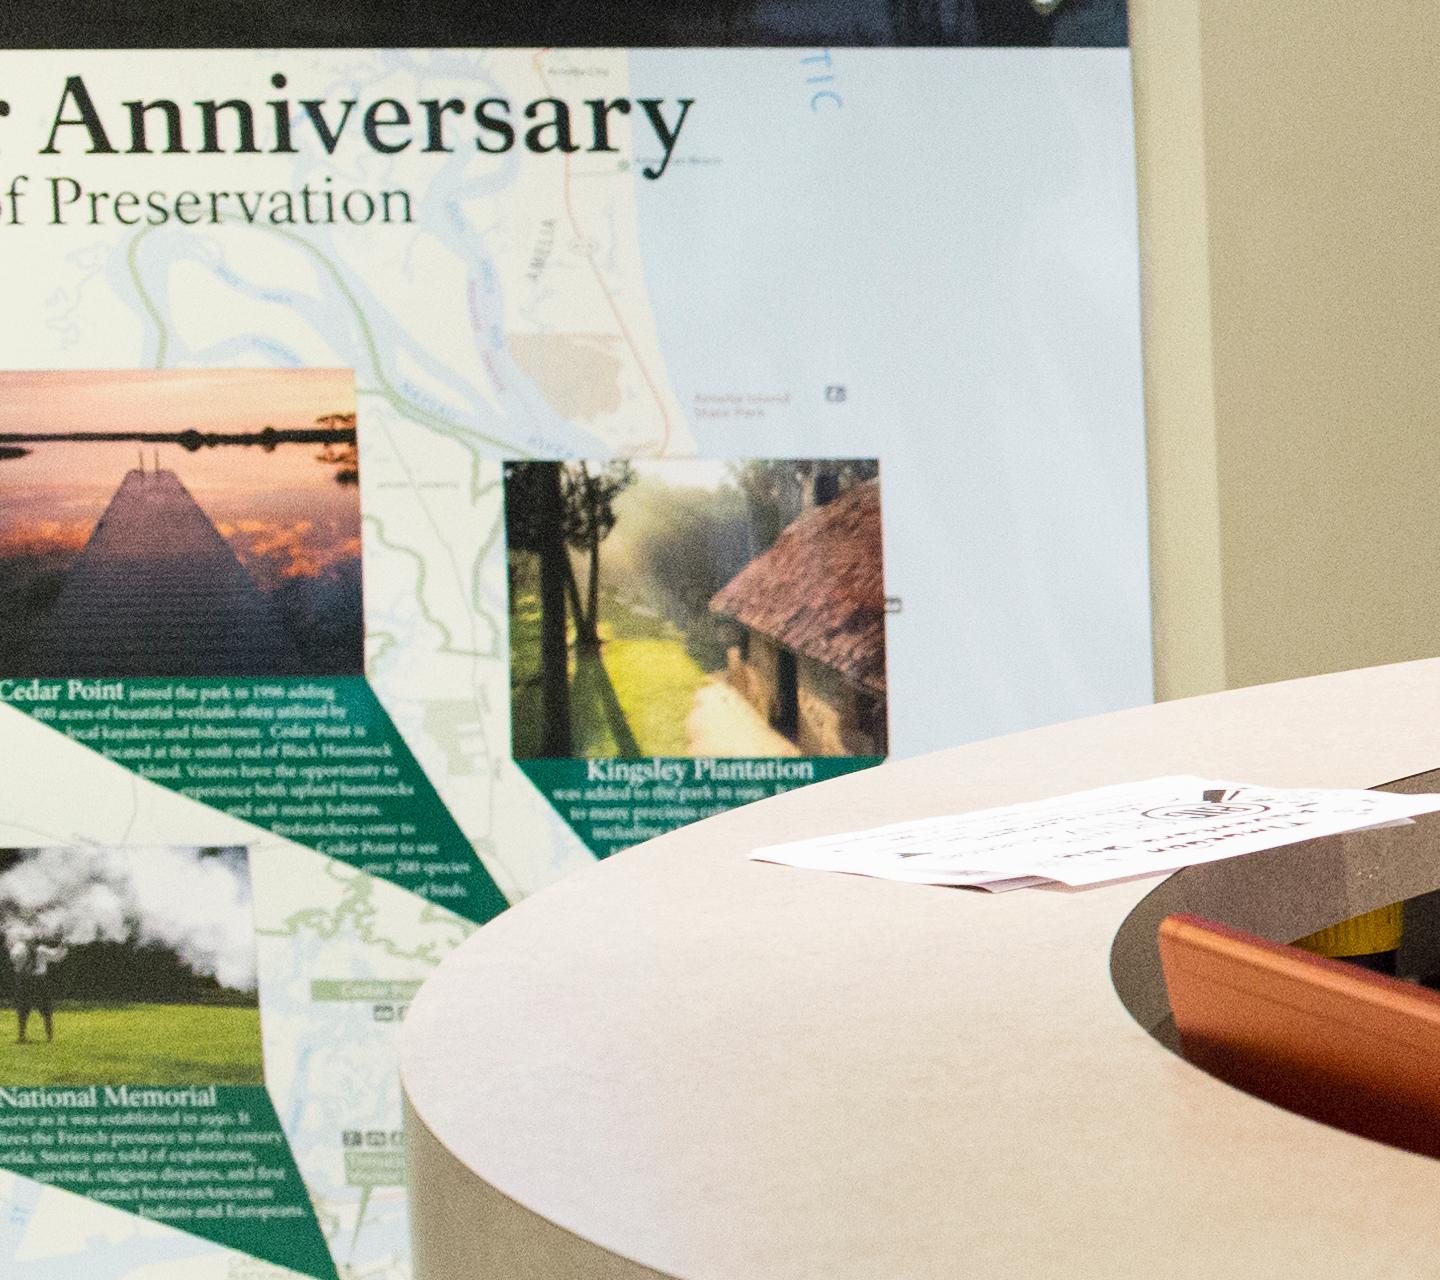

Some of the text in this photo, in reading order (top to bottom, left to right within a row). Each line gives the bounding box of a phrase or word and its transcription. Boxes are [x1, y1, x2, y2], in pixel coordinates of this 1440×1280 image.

[38, 72, 695, 181] Anniversary
[0, 174, 416, 226] f Preservation
[0, 679, 61, 701] Cedar
[67, 678, 124, 701] Point
[586, 758, 814, 786] Kingsley Plantation
[0, 1084, 217, 1108] National Memorial
